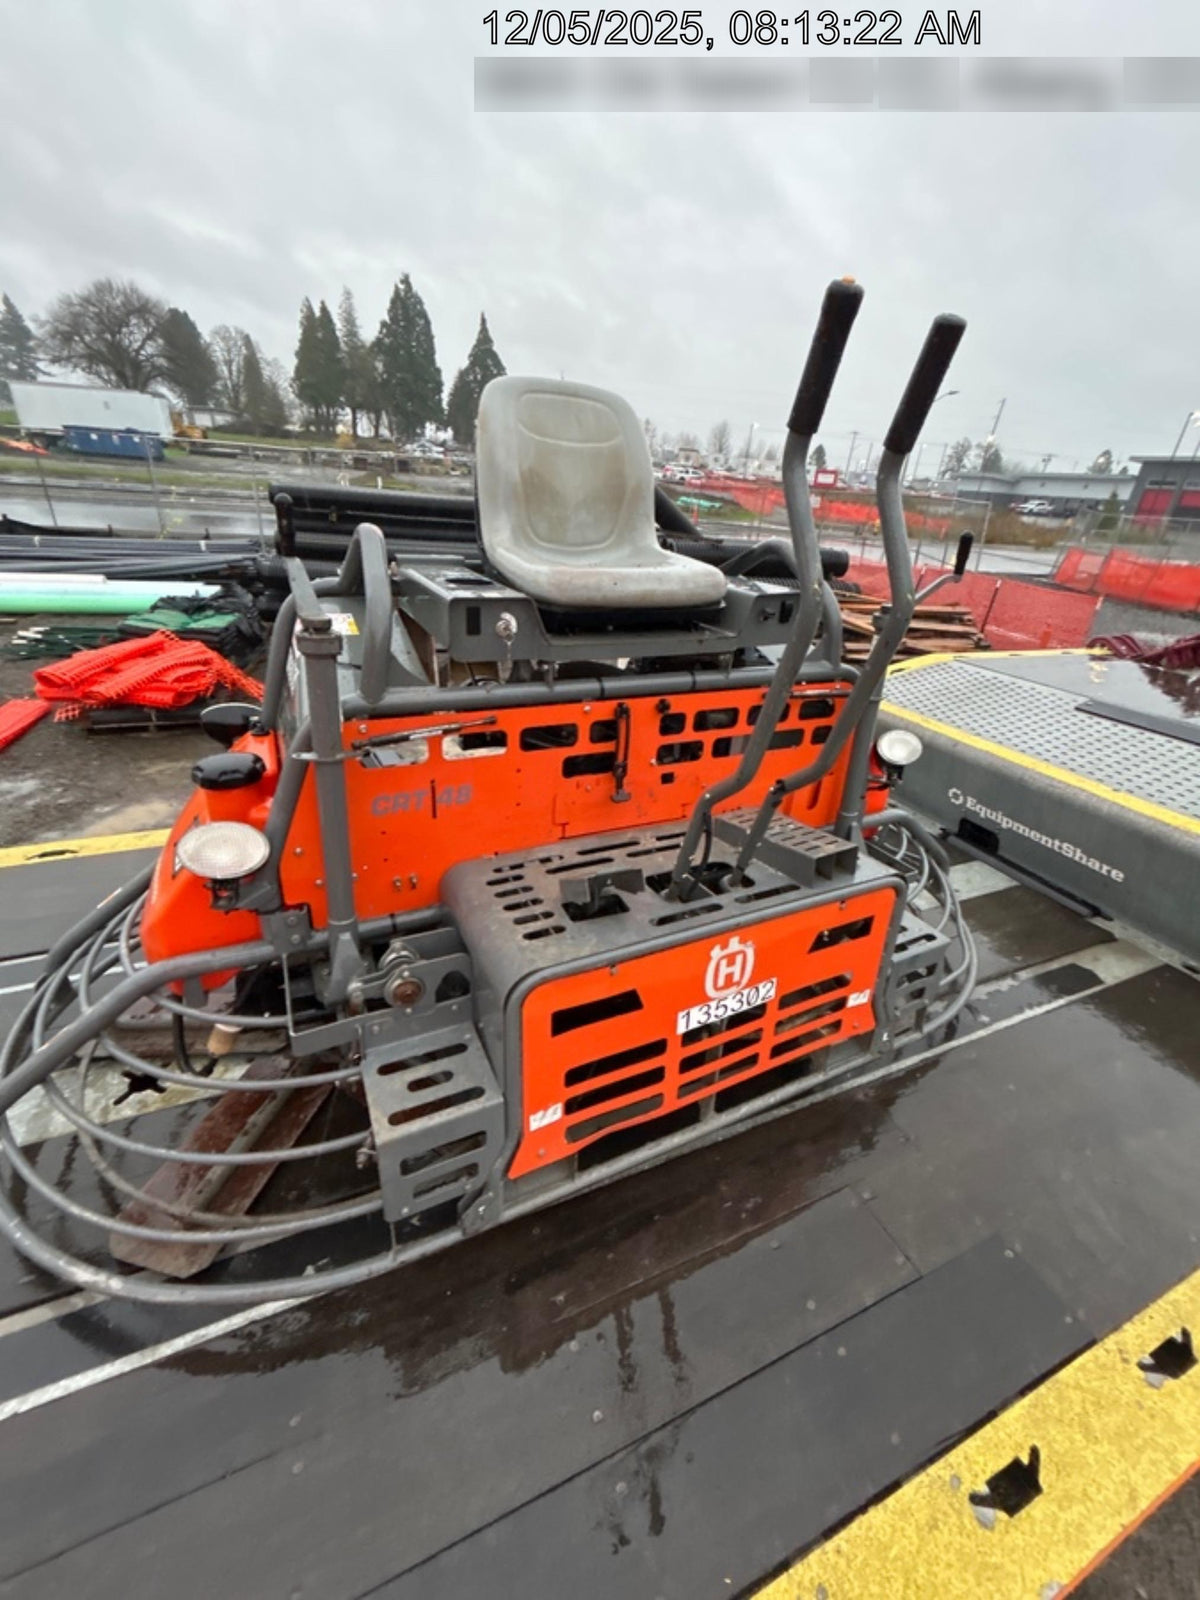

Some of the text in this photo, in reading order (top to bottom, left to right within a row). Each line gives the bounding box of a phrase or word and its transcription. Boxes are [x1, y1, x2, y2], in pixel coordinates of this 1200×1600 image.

[371, 783, 474, 817] CRT 48
[965, 796, 1125, 882] EquipmentShare
[680, 979, 775, 1031] 135302
